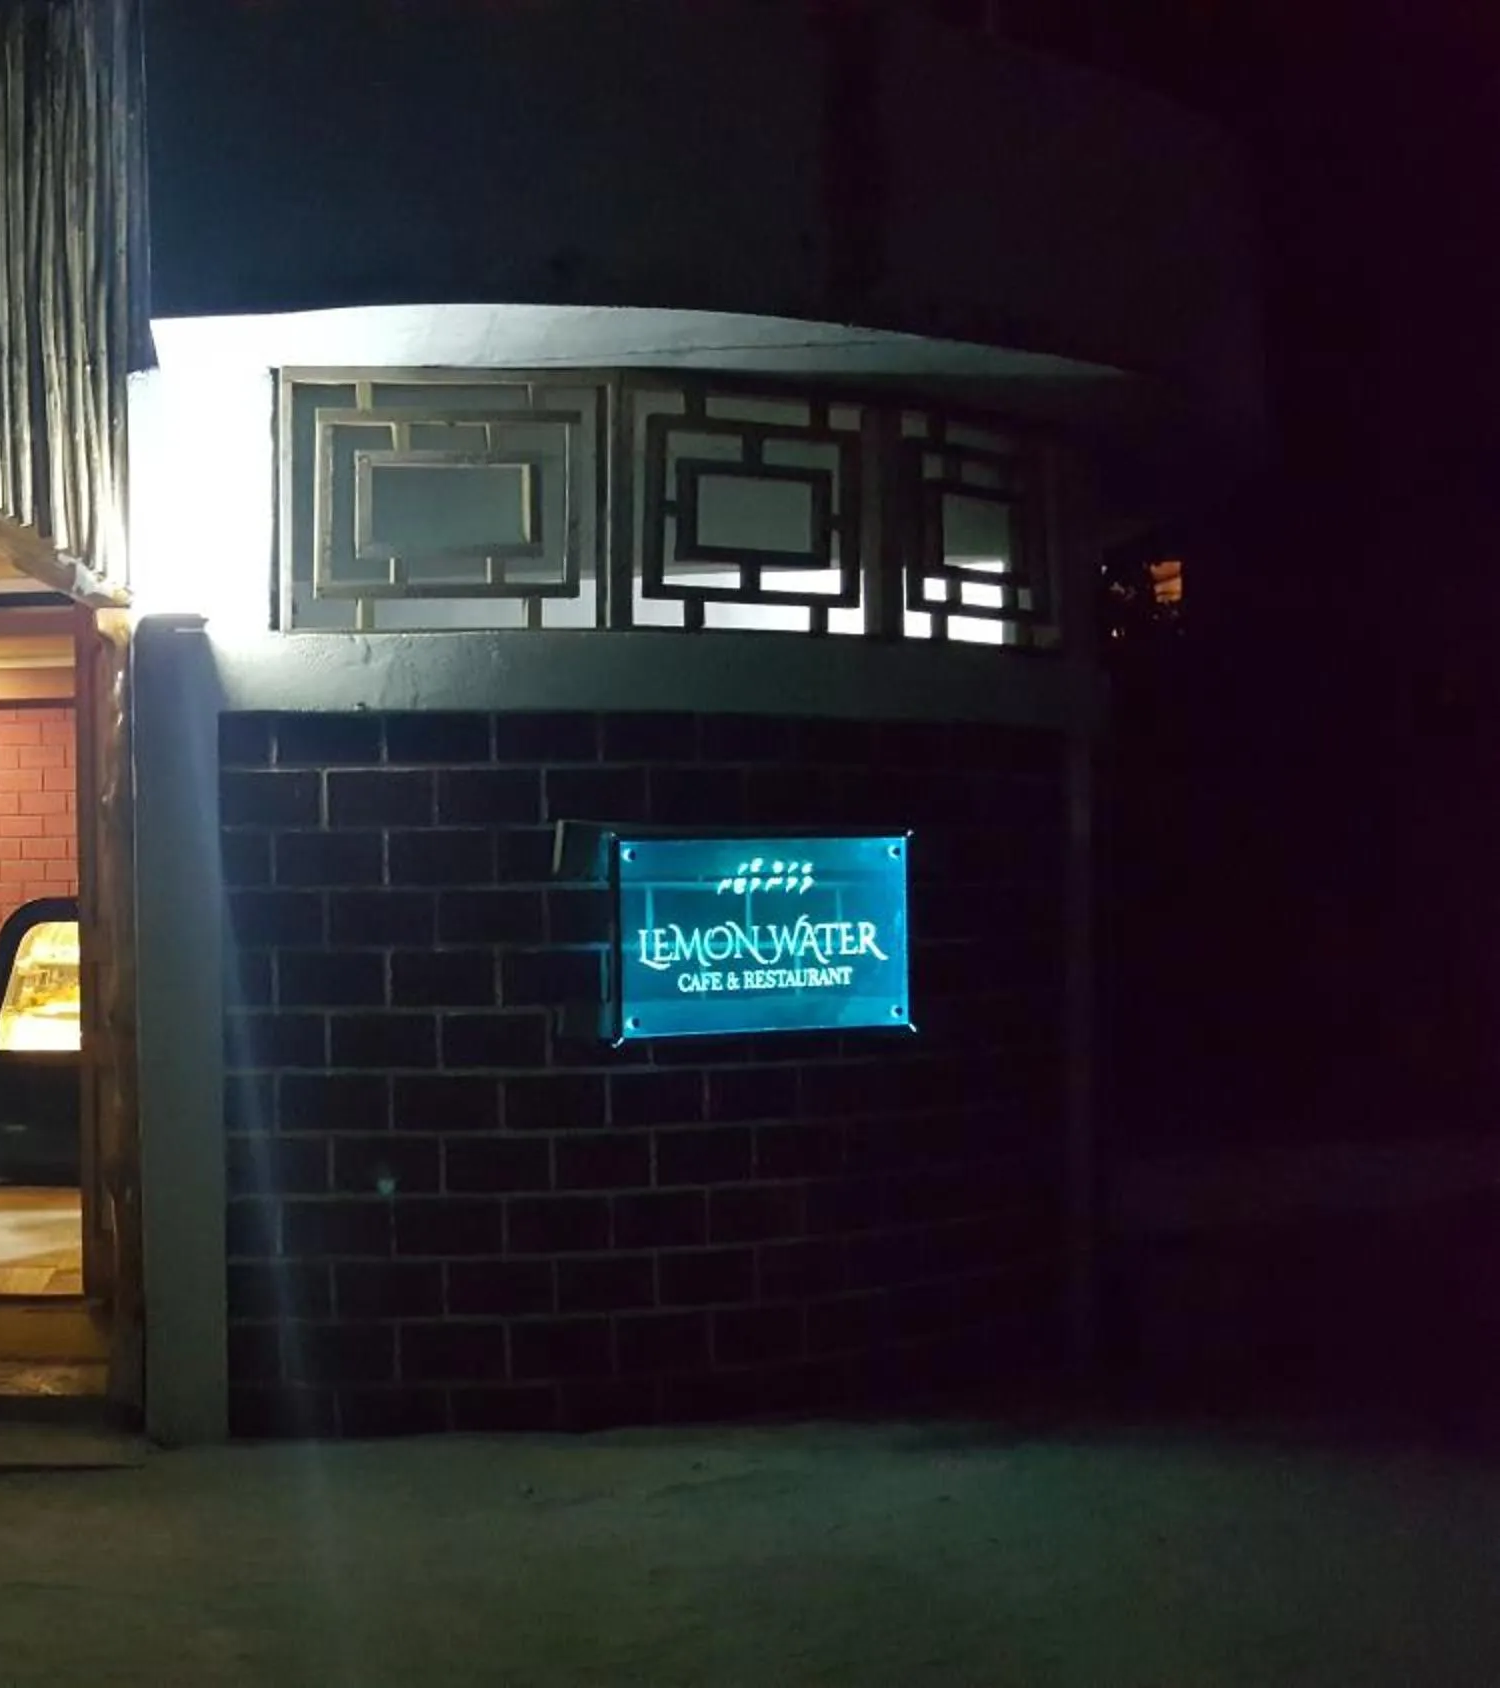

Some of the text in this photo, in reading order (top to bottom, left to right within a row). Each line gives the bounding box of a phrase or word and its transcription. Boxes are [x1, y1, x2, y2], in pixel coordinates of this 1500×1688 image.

[638, 914, 888, 970] LEMON WATER
[677, 966, 853, 992] CAFE & RESTAURANT
